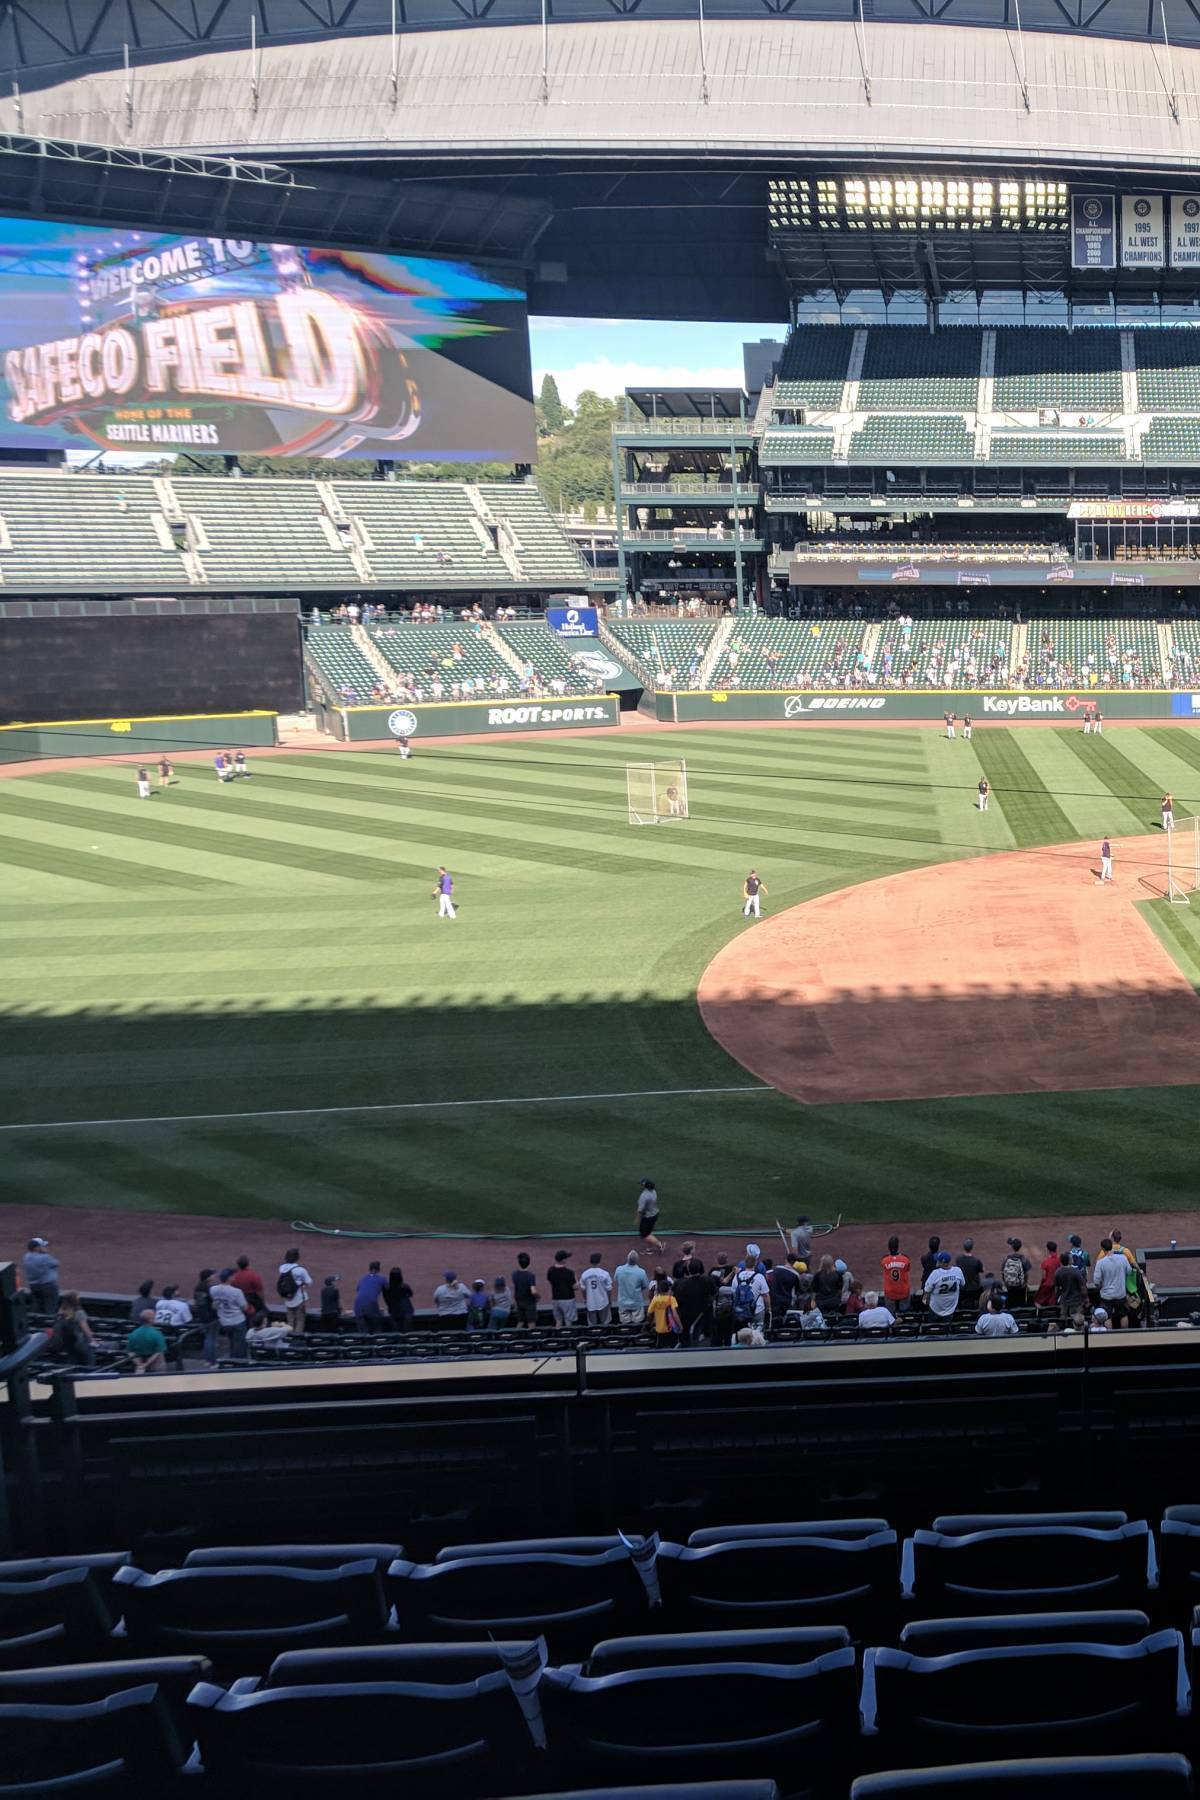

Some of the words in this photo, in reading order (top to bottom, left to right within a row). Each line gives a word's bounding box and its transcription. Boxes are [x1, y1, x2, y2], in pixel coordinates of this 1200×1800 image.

[1134, 223, 1151, 233] 1995
[1184, 223, 1199, 233] 1997
[1128, 237, 1139, 247] A.L.
[1140, 237, 1158, 247] WEST
[1177, 237, 1188, 247] A.L.
[1124, 251, 1162, 262] CHAMPIONS
[89, 241, 203, 300] WELCOME
[207, 237, 254, 262] TO
[5, 327, 138, 423] SAFECO
[143, 288, 359, 414] FIELD
[115, 410, 144, 419] HOME
[147, 409, 162, 419] OF
[165, 408, 192, 418] THE
[106, 424, 150, 441] SEATTLE
[151, 424, 220, 444] MARINERS
[807, 698, 886, 708] BOEING
[983, 696, 1065, 714] KeyBank
[488, 706, 542, 725] ROOT
[541, 707, 604, 722] SPORTS
[891, 1269, 900, 1281] 9
[590, 1280, 598, 1290] 5
[938, 1281, 958, 1294] 24
